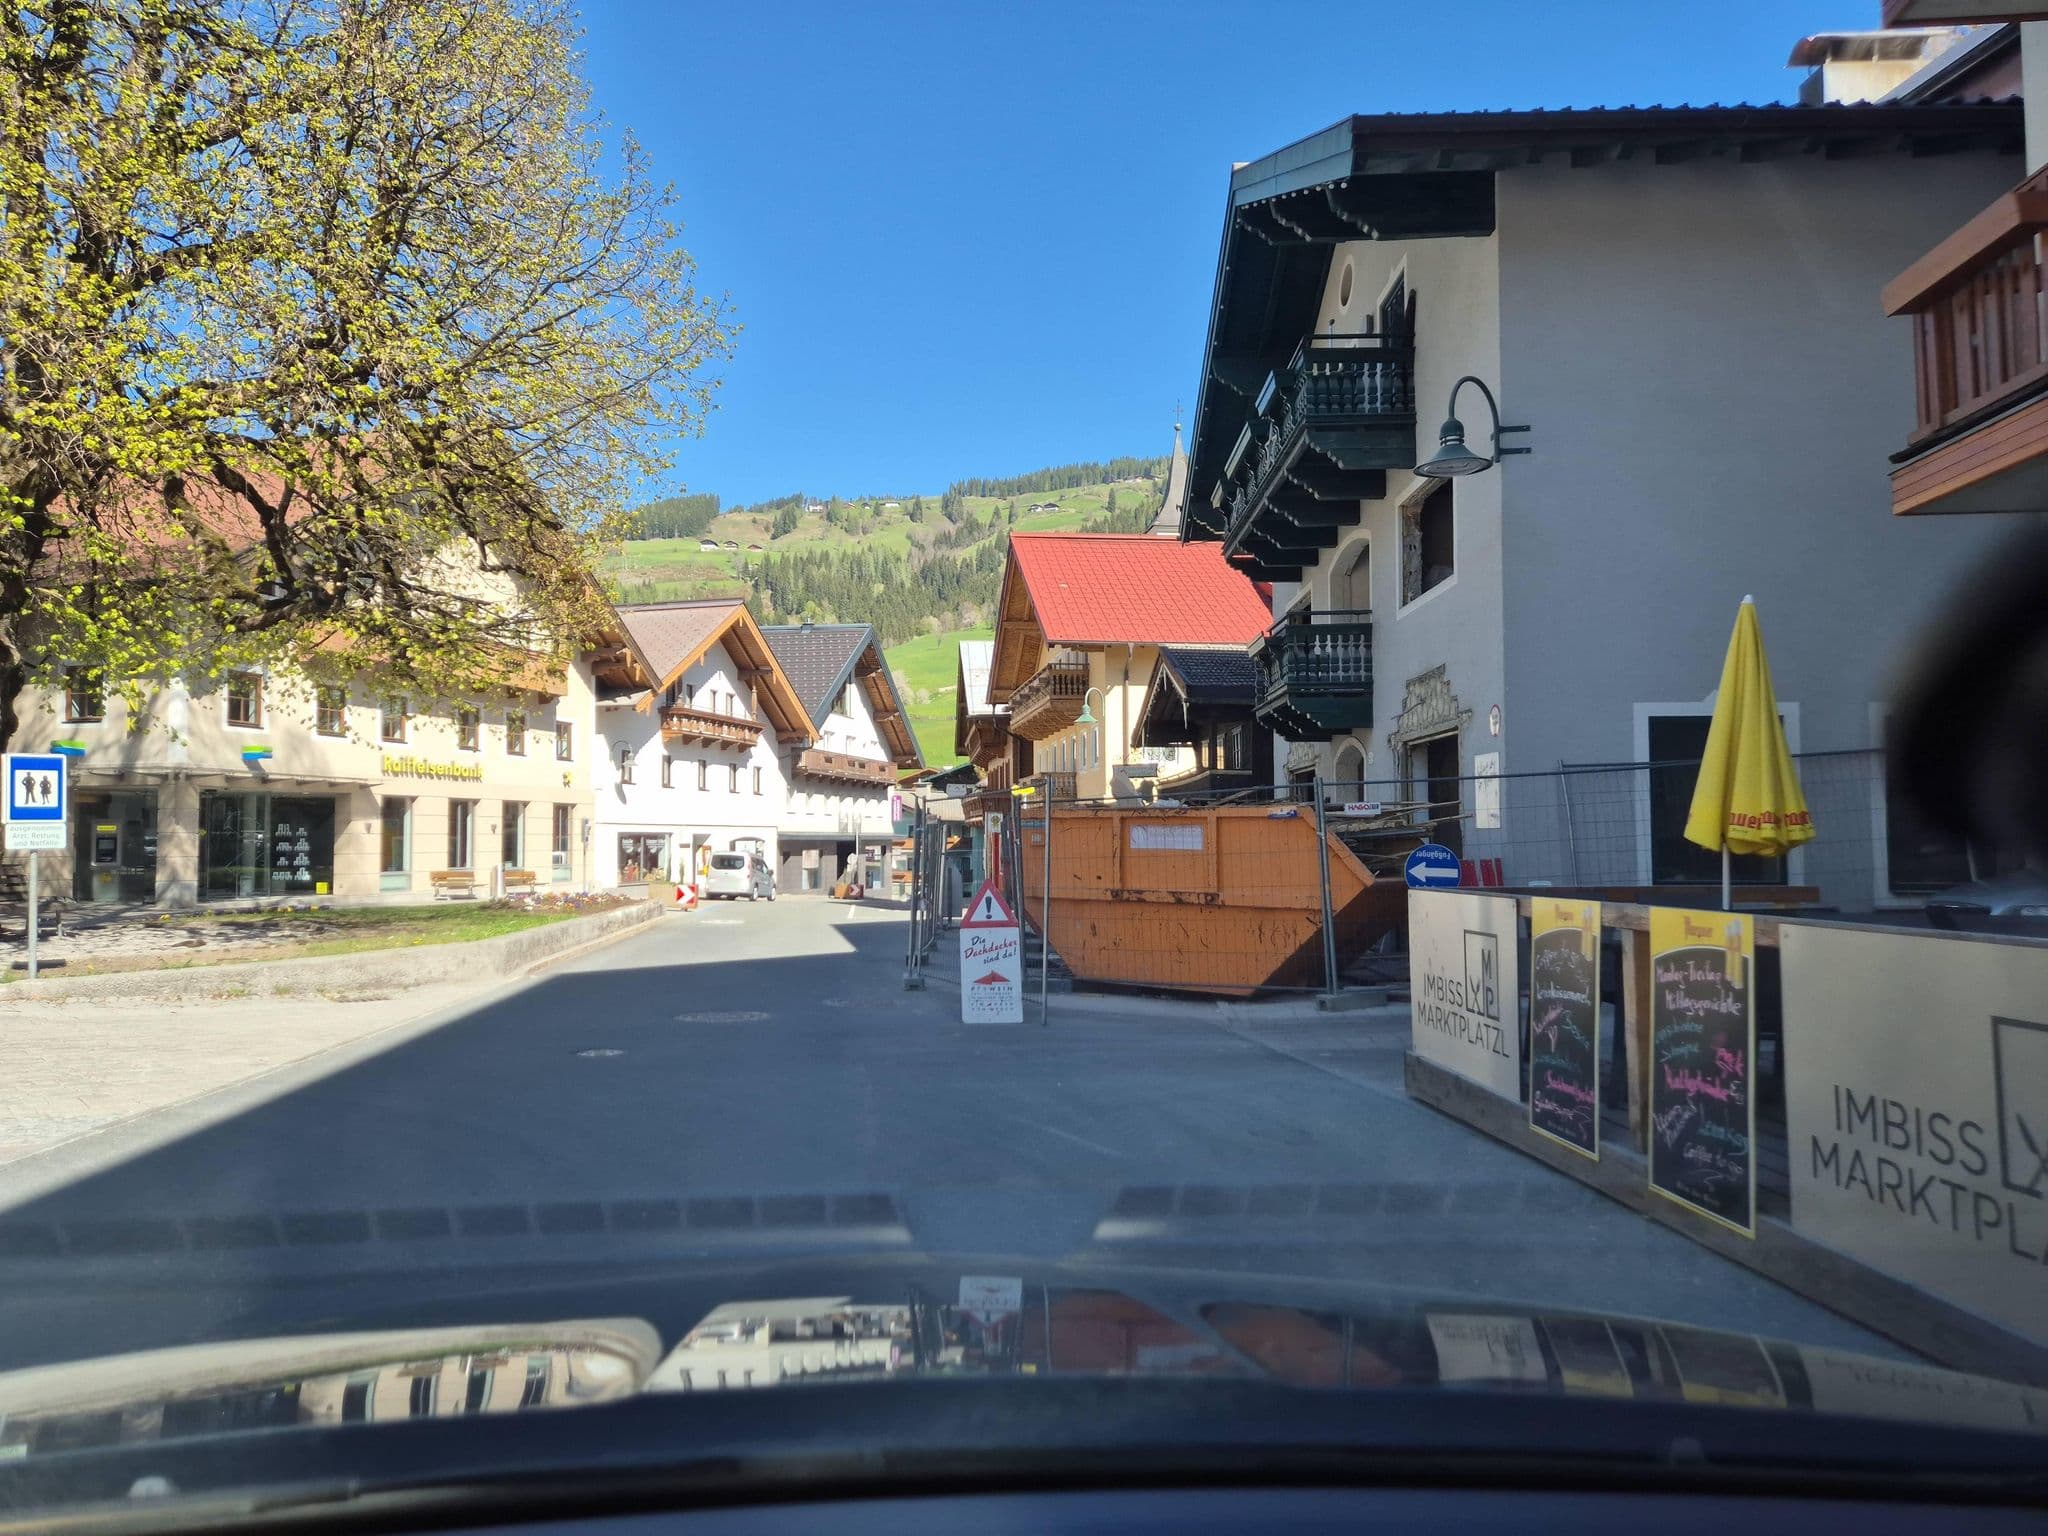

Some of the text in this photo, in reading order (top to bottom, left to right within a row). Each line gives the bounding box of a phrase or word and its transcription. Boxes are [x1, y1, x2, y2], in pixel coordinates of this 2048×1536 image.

[383, 755, 484, 778] Raiffeisenbank
[1416, 850, 1451, 860] Fußgänger
[964, 938, 1018, 959] Dachdecker
[971, 935, 986, 946] Die
[983, 946, 1017, 965] sind da!
[1424, 973, 1463, 1008] IMBISS
[1417, 1001, 1510, 1058] MARKTPLATZL
[1834, 1084, 1987, 1176] IMBISS
[1811, 1134, 2048, 1266] MARKTPL
